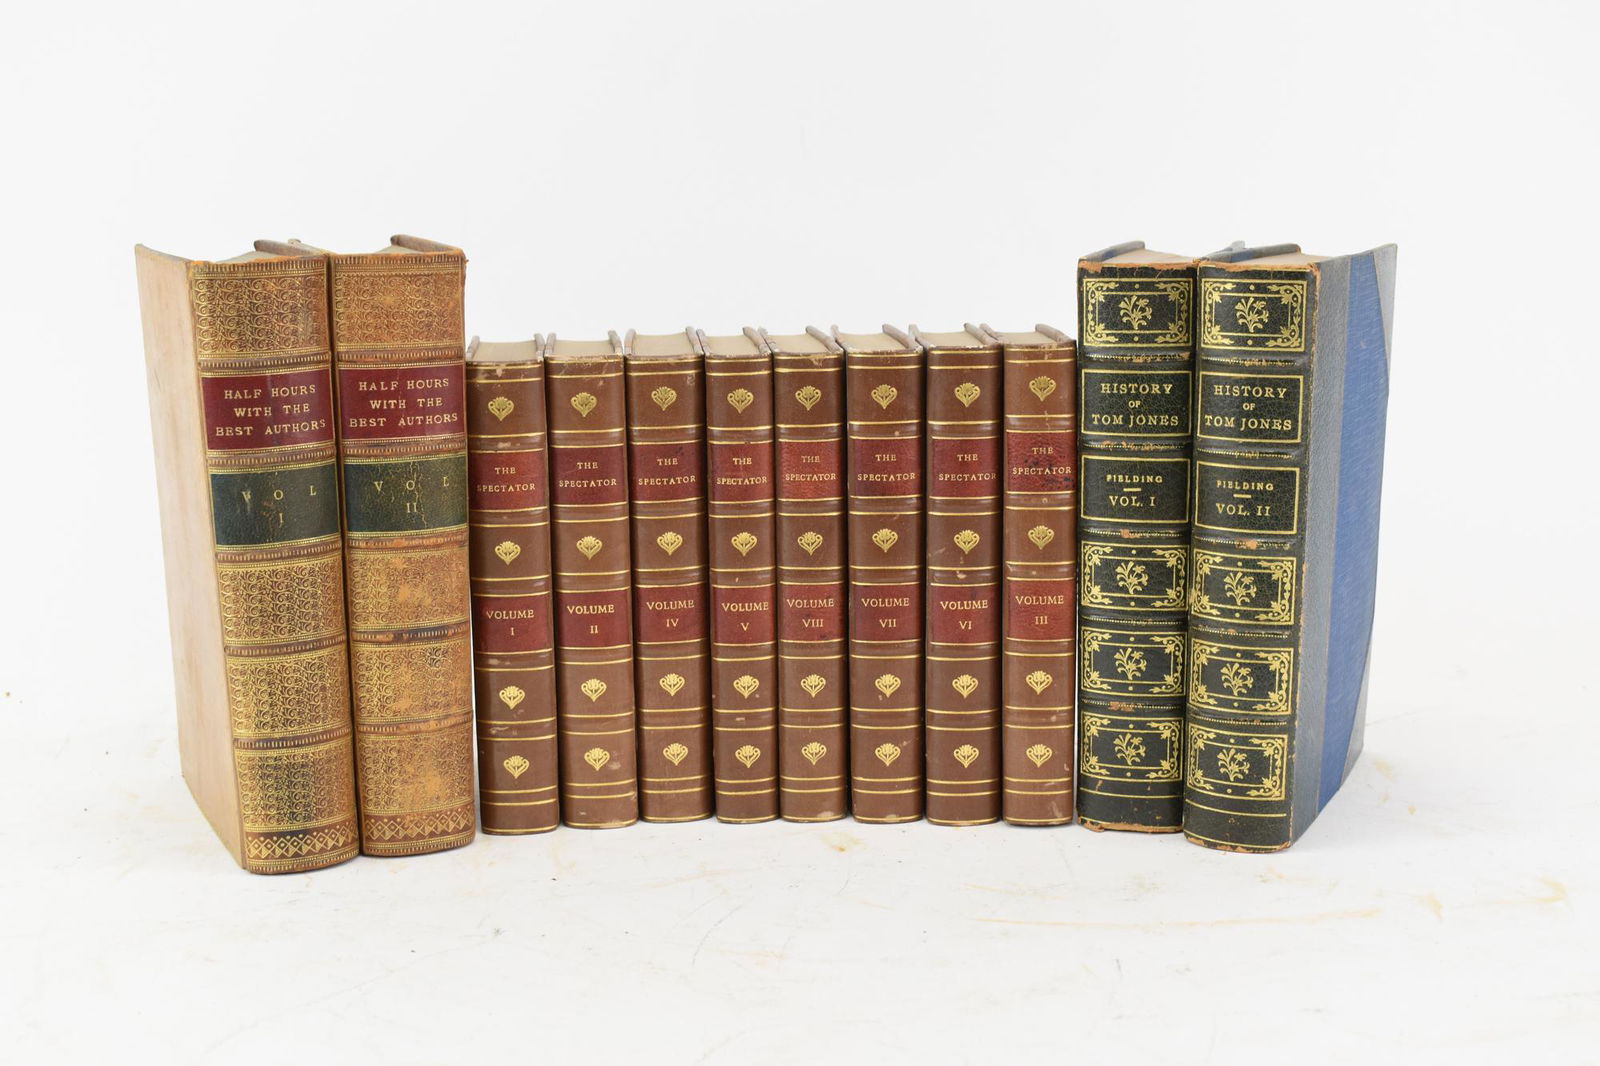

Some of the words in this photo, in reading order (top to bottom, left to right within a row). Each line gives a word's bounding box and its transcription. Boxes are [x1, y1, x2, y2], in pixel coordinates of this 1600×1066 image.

[359, 381, 398, 391] HALF
[407, 378, 449, 390] HOURS
[1100, 383, 1173, 394] HISTORY
[224, 389, 262, 400] HALF
[272, 384, 316, 398] HOURS
[1214, 384, 1287, 398] HISTORY
[370, 399, 406, 410] WITH
[417, 398, 443, 407] THE
[234, 406, 272, 417] WITH
[283, 403, 310, 414] THE
[350, 418, 386, 427] BEST
[398, 412, 458, 426] AUTHORS
[1092, 414, 1123, 425] TOM
[1129, 414, 1179, 427] JONES
[1204, 414, 1235, 427] TOM
[1240, 418, 1292, 431] JONES
[216, 426, 253, 436] BEST
[265, 419, 326, 435] AUTHORS
[576, 462, 598, 470] THE
[657, 458, 678, 466] THE
[494, 466, 516, 475] THE
[1013, 466, 1071, 475] SPECTATOR
[638, 475, 696, 486] SPECTATOR
[717, 477, 767, 485] SPECTATOR
[857, 473, 915, 481] SPECTATOR
[939, 473, 997, 481] SPECTATOR
[1106, 474, 1163, 483] FIELDING
[477, 483, 535, 492] SPECTATOR
[559, 478, 617, 488] SPECTATOR
[1216, 480, 1274, 491] FIELDING
[1109, 496, 1143, 507] VOL.
[1150, 497, 1156, 506] I
[406, 502, 417, 513] II
[1216, 503, 1250, 516] VOL.
[1257, 505, 1270, 516] II
[786, 599, 834, 608] VOLUME
[861, 598, 909, 607] VOLUME
[940, 600, 988, 610] VOLUME
[1015, 595, 1064, 605] VOLUME
[567, 604, 615, 615] VOLUME
[646, 600, 694, 611] VOLUME
[722, 602, 769, 612] VOLUME
[486, 610, 534, 620] VOLUME
[1035, 616, 1048, 624] III
[666, 618, 679, 627] IV
[741, 622, 749, 631] V
[802, 619, 824, 628] VIII
[879, 619, 896, 628] VII
[959, 621, 972, 630] VI
[510, 627, 514, 636] I
[590, 625, 599, 634] II
